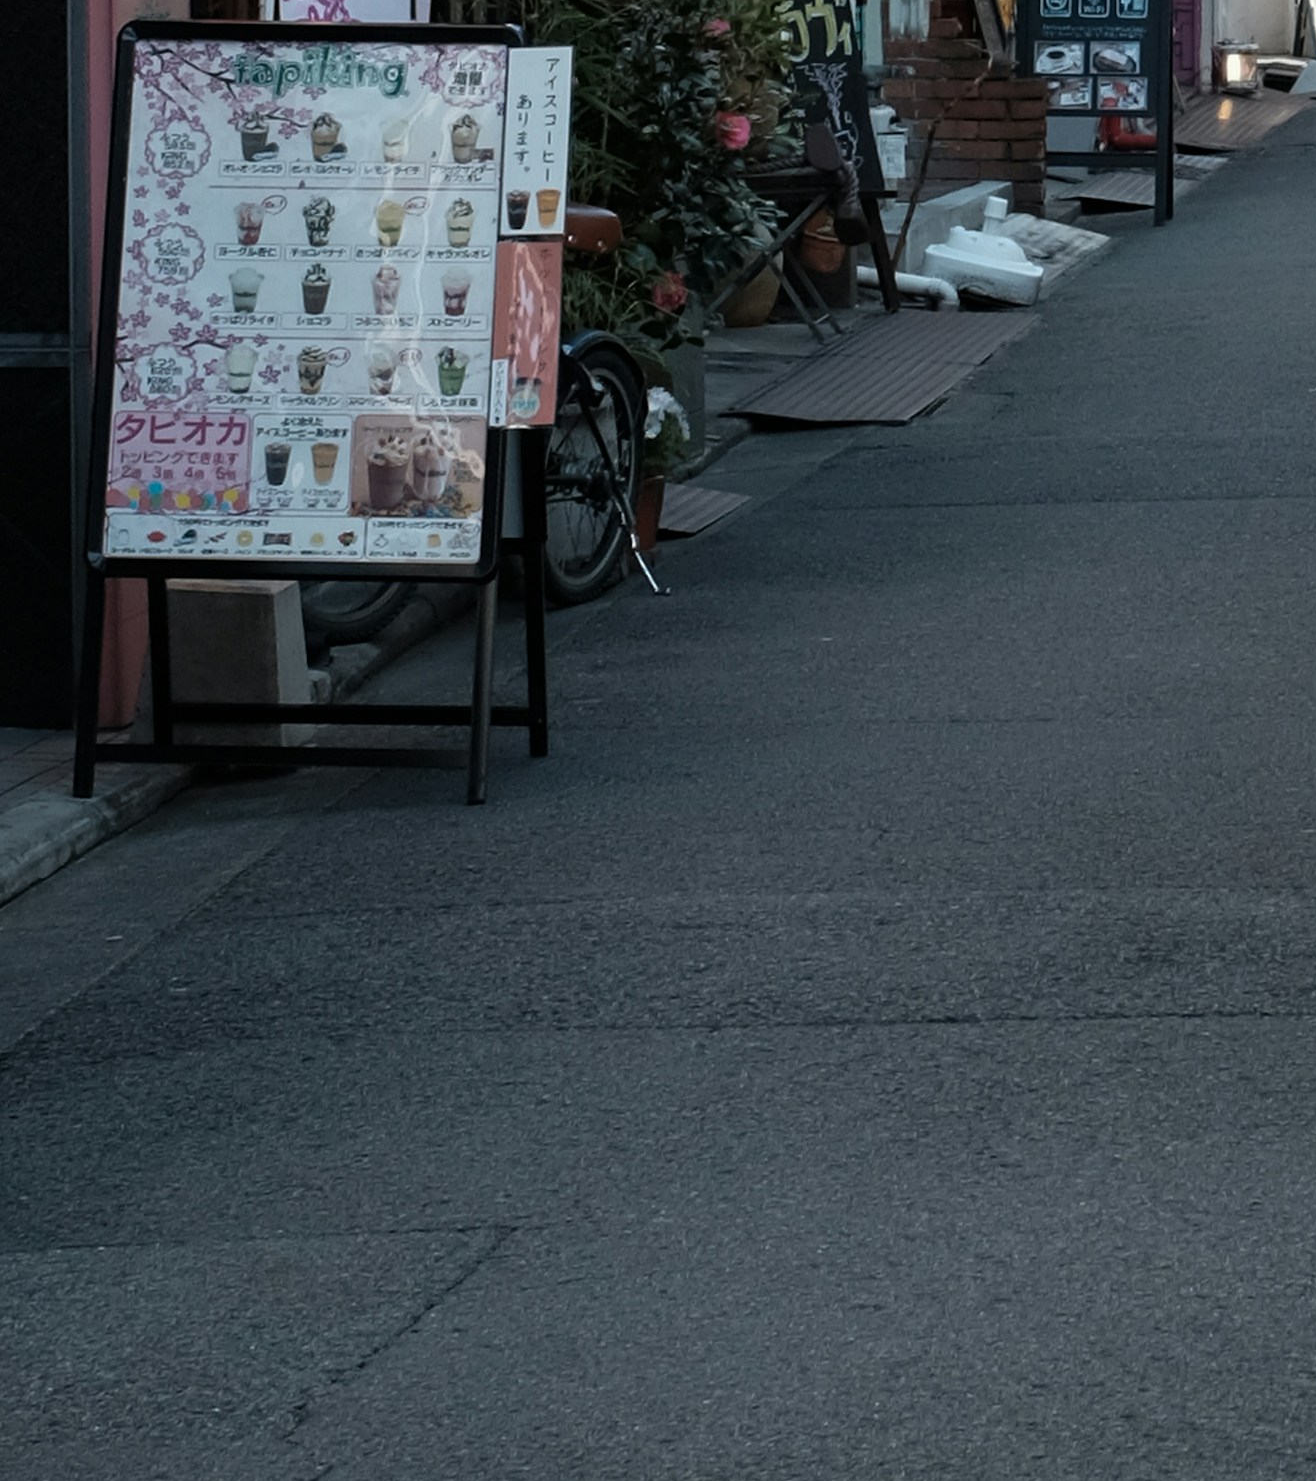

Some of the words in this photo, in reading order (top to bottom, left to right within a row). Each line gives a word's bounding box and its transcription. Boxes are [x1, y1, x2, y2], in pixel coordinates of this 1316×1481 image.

[231, 43, 410, 100] tapiking
[514, 94, 533, 175] あります。
[540, 57, 561, 183] アイスコーヒー
[116, 413, 248, 445] タピオカ
[120, 449, 240, 466] トッピングできます
